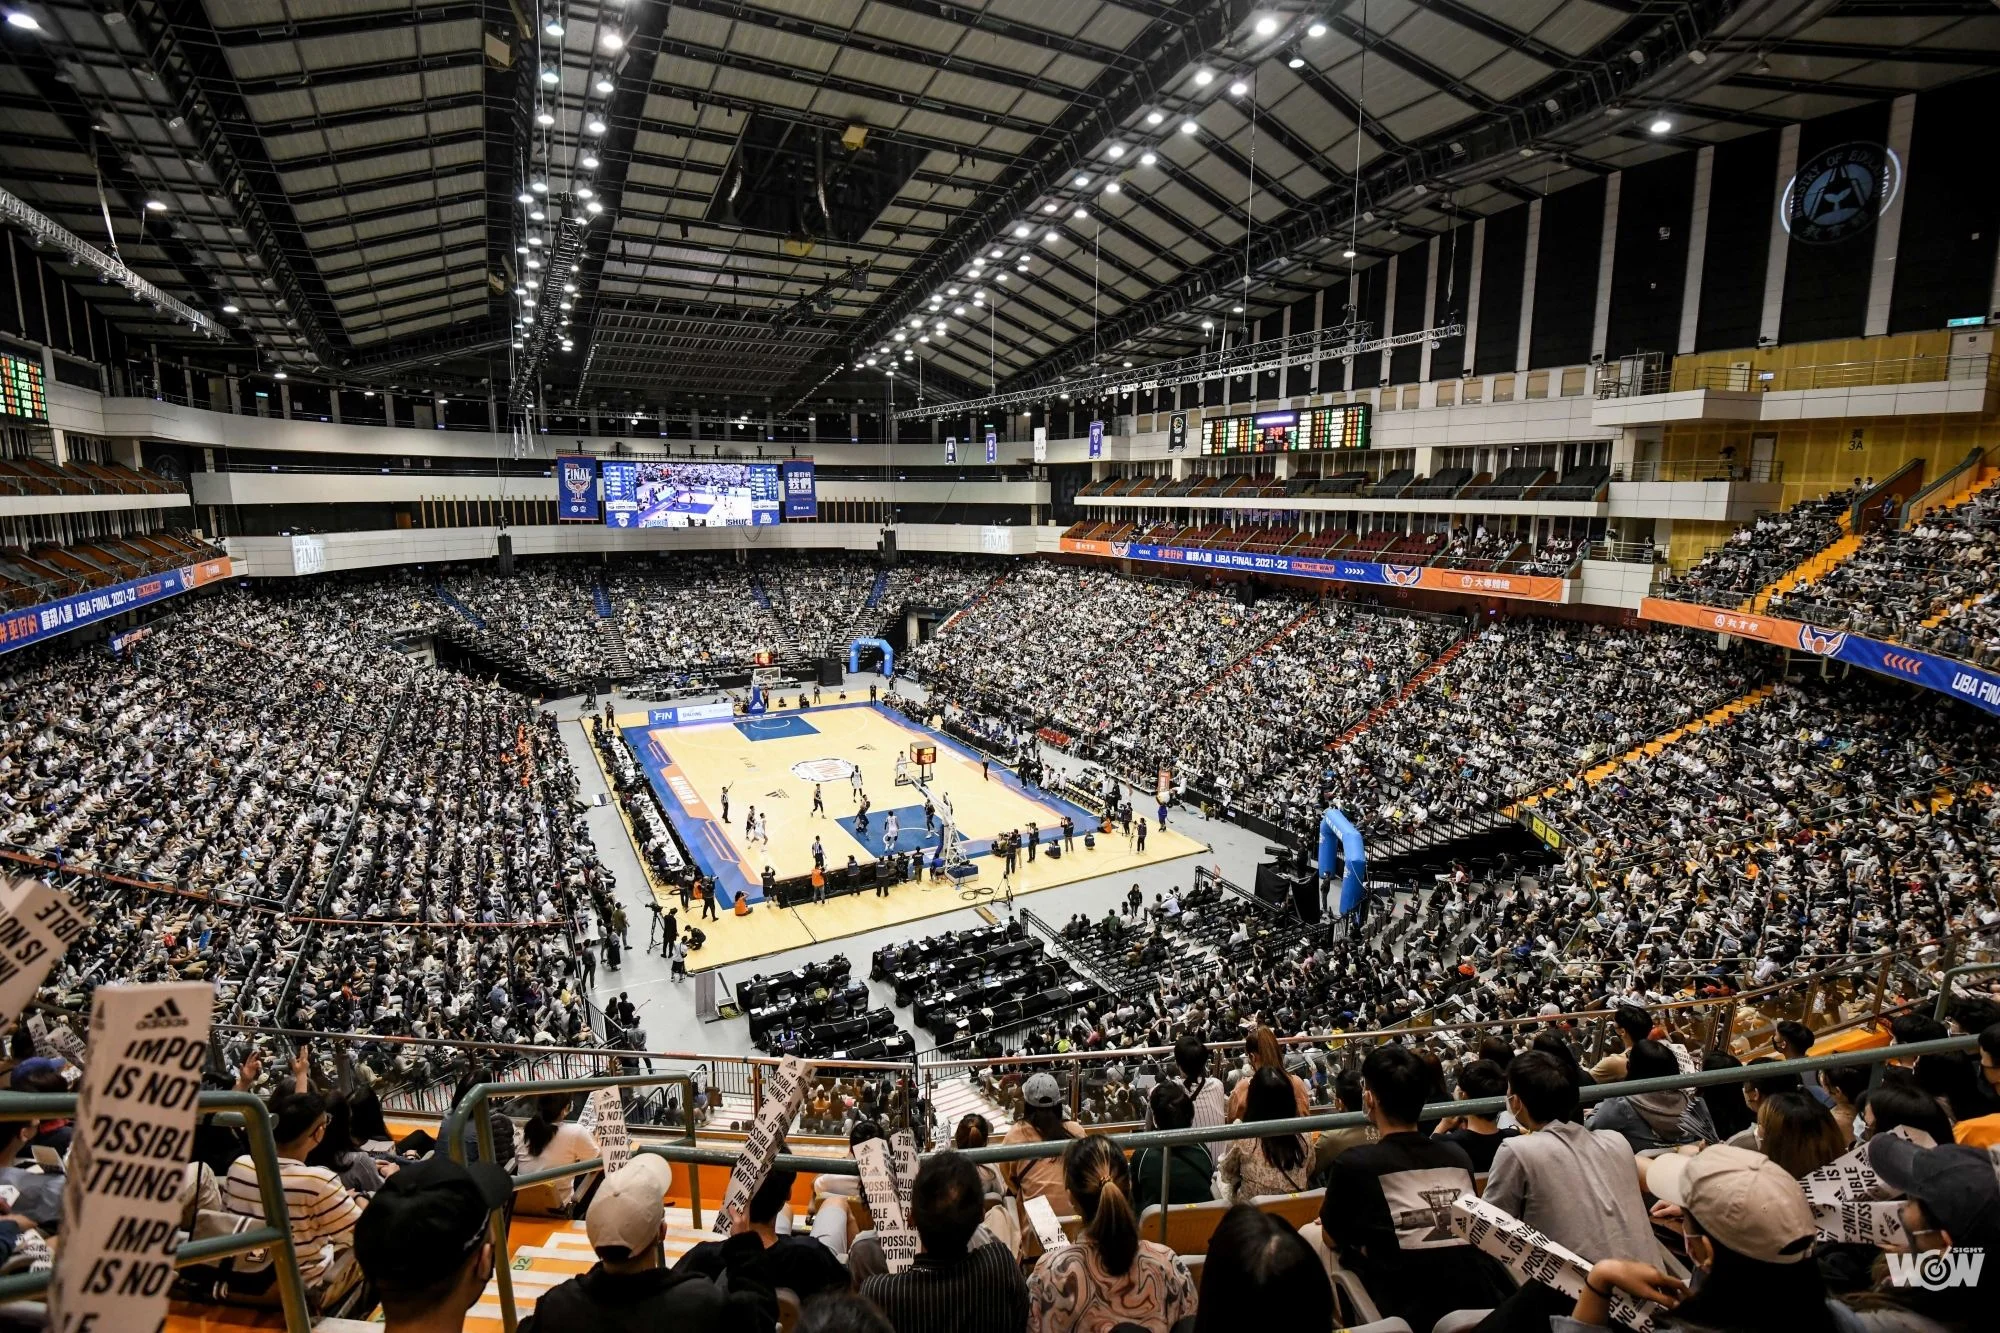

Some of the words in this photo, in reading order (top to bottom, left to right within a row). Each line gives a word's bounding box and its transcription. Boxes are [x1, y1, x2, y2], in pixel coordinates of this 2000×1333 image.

[1848, 440, 1864, 451] 3A
[564, 468, 592, 480] FINAL
[1215, 554, 1231, 564] UBA
[1231, 556, 1254, 567] FINAL
[75, 601, 92, 618] UBA
[91, 593, 113, 613] FINAL
[1951, 671, 1979, 697] UBA
[1977, 681, 2000, 706] FIN
[103, 1063, 142, 1099] IS
[598, 1111, 605, 1122] IS
[607, 1162, 617, 1173] IS
[82, 1257, 122, 1295] IS
